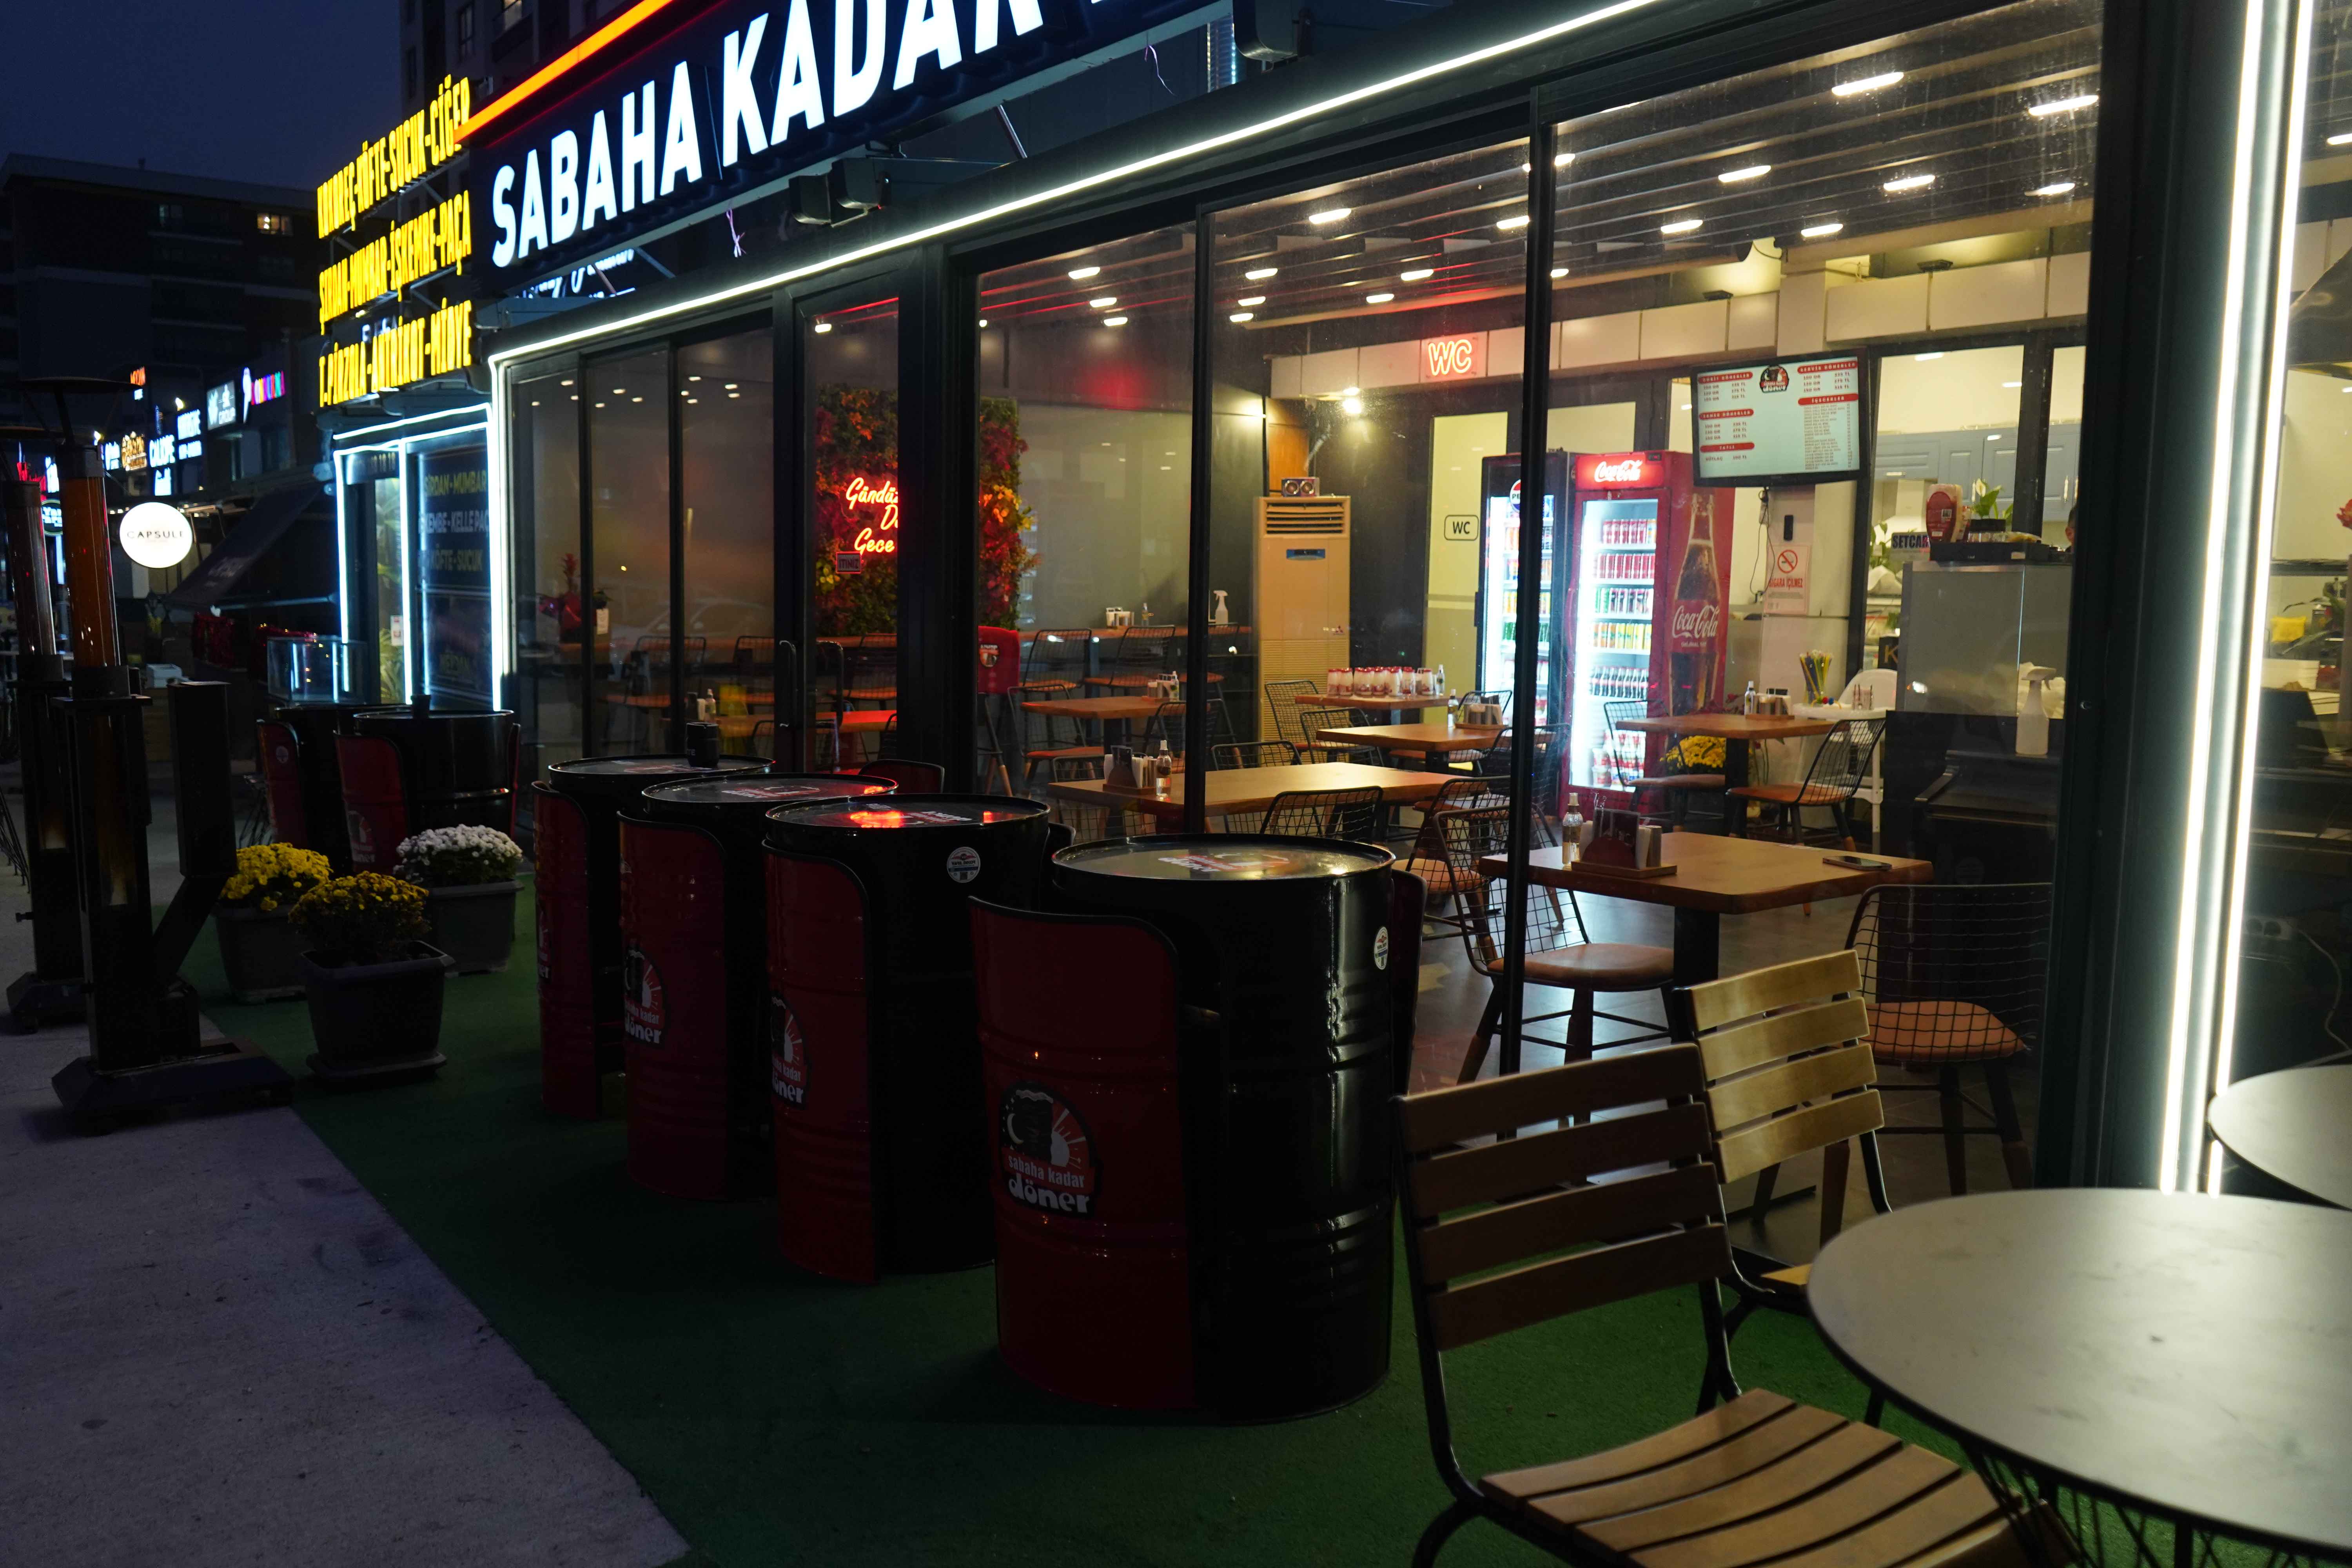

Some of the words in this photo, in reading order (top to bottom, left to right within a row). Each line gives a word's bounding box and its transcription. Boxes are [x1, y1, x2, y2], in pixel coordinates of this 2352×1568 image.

[492, 61, 702, 268] SABAHA
[1428, 339, 1472, 376] WC
[1594, 459, 1643, 482] Coca-Cola
[854, 528, 895, 556] Gece
[1452, 521, 1471, 535] WC
[1892, 534, 1930, 549] SETCAR
[1672, 605, 1720, 639] Coca-Cola
[1008, 1155, 1045, 1180] sabaha
[1048, 1167, 1085, 1189] kadar
[1008, 1173, 1091, 1214] döner
